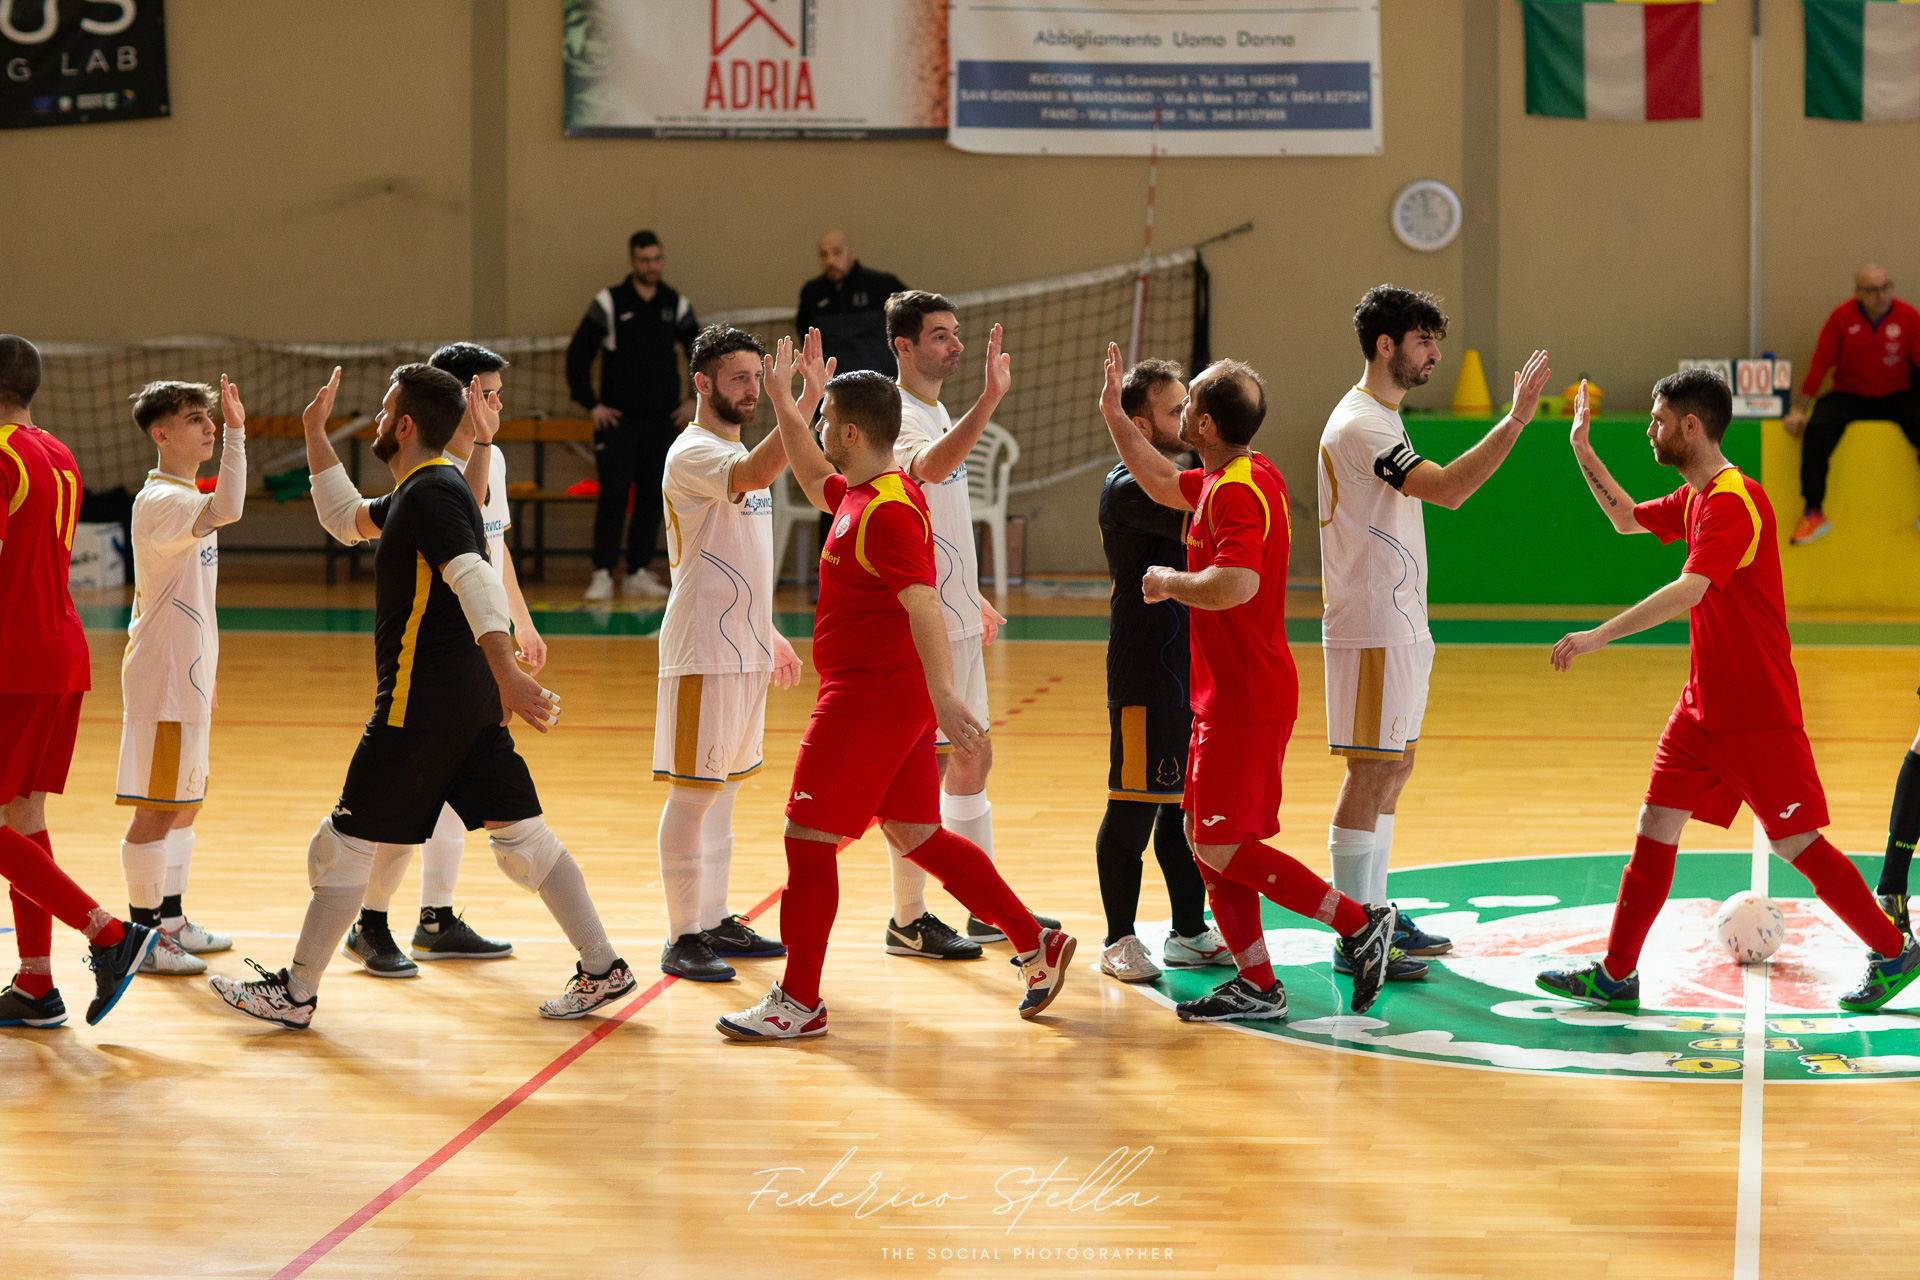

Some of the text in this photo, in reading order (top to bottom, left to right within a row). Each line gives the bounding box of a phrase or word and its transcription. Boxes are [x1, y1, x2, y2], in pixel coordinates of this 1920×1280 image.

[1033, 29, 1297, 50] Abbigliamento Uomo Donna
[60, 45, 138, 77] LAB
[703, 58, 817, 111] ADRIA
[1028, 72, 1094, 87] RICCIONE
[1125, 73, 1179, 88] Gramsci
[959, 88, 988, 102] SAN
[989, 89, 1053, 103] GIOVANNI
[1056, 90, 1070, 103] IN
[1072, 90, 1154, 105] MARIGNANO
[1201, 91, 1234, 105] Mare
[1040, 107, 1079, 121] FANO
